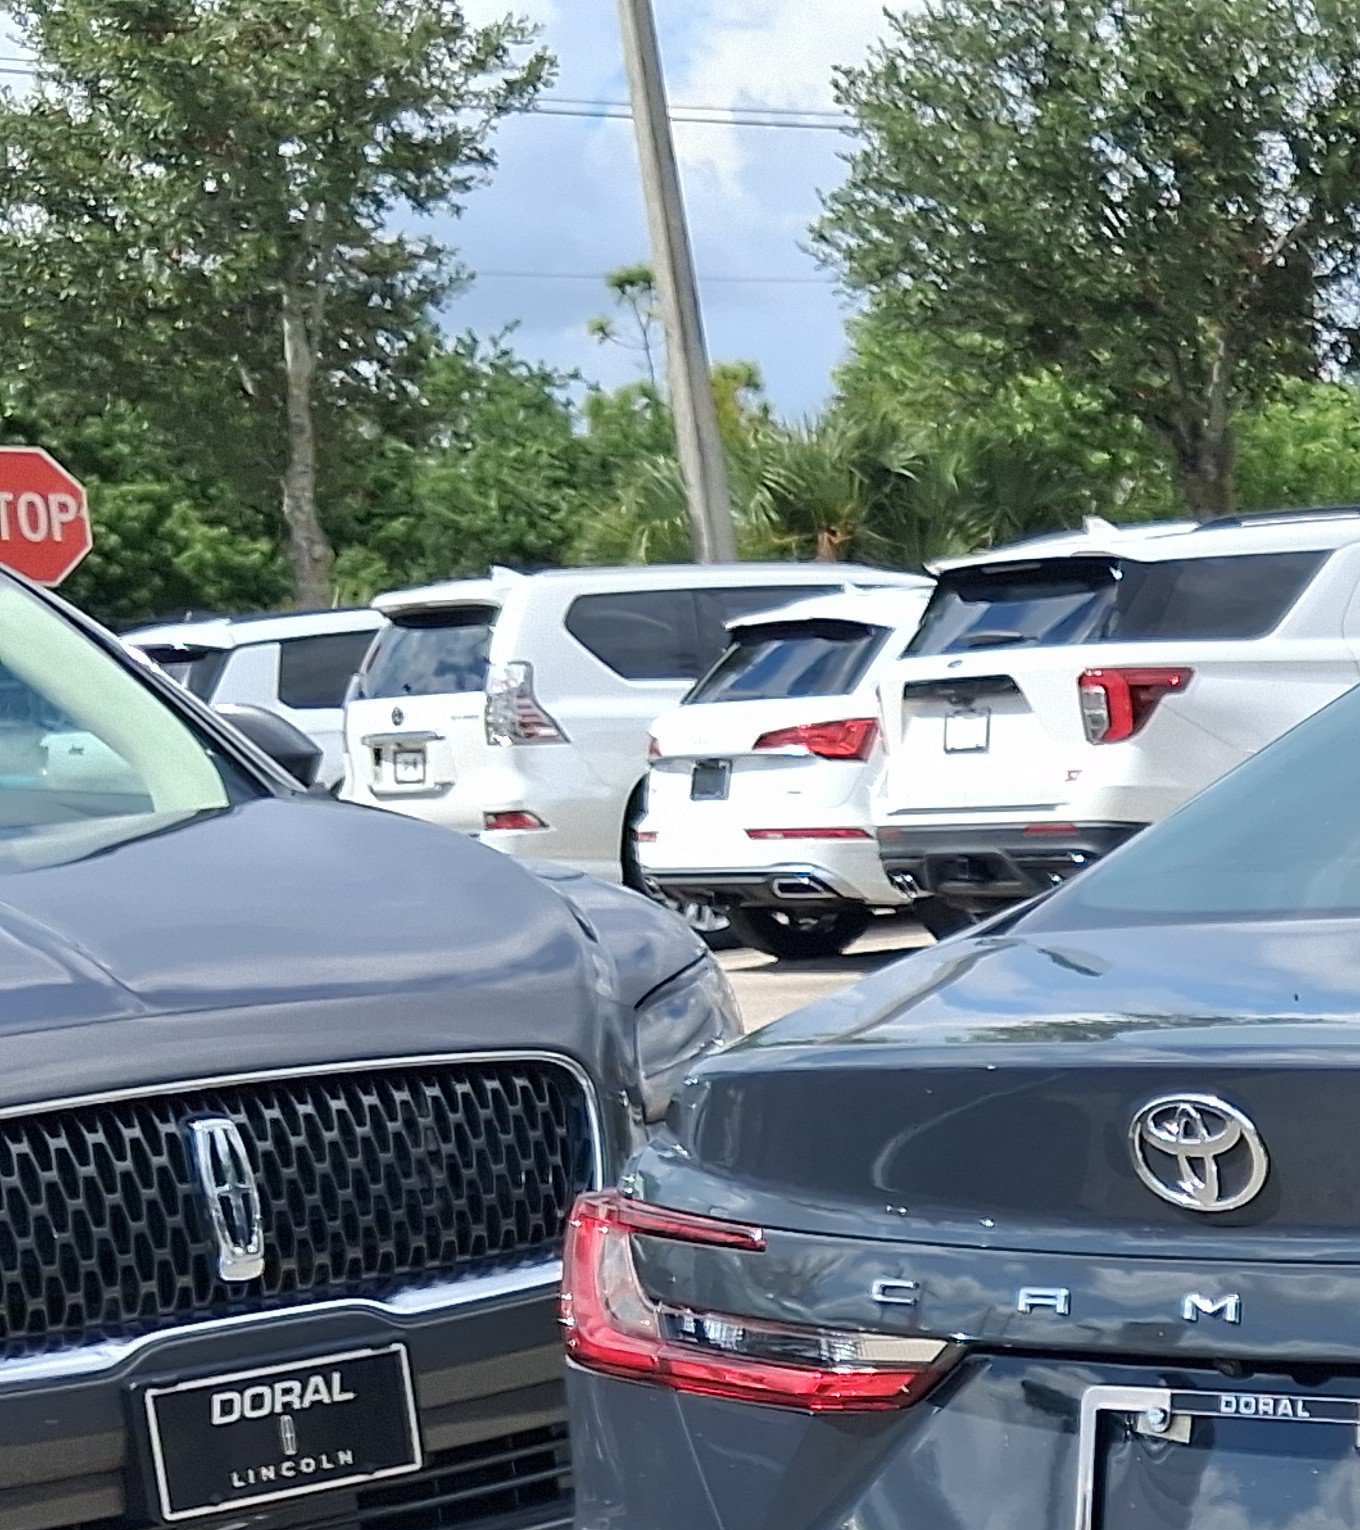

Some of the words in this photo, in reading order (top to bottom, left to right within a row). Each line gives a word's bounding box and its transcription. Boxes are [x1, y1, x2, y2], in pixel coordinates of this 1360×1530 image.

[0, 491, 79, 542] TOP
[210, 1371, 356, 1426] DORAL
[1220, 1395, 1311, 1418] DORAL
[230, 1449, 354, 1488] LINCOLN
